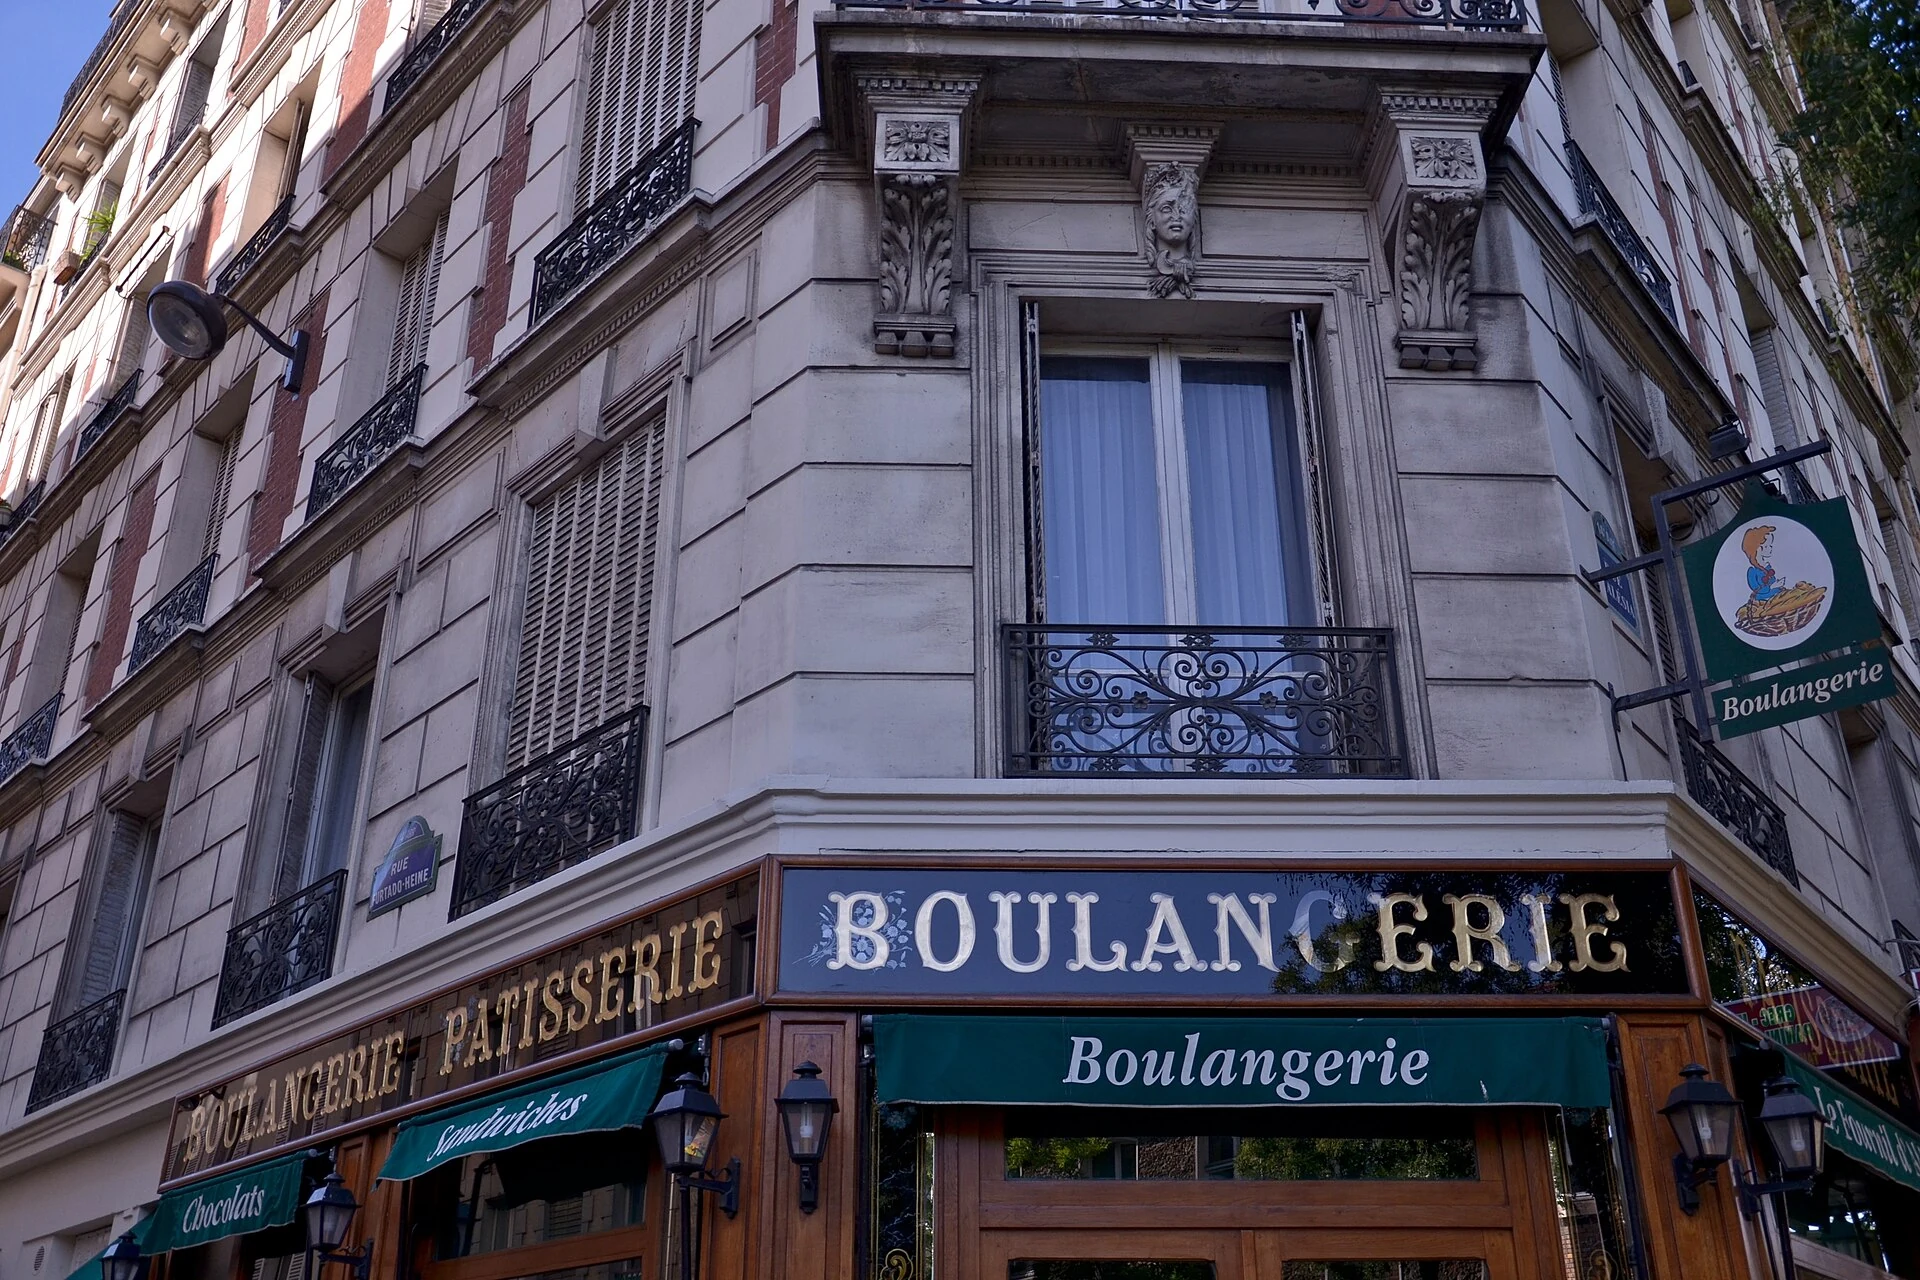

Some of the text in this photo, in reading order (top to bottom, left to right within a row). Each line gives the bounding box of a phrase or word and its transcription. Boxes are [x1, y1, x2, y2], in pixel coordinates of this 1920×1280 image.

[1722, 661, 1883, 721] Boulangerie
[391, 857, 409, 876] RUE
[827, 890, 1631, 973] BOULANGERIE
[184, 907, 723, 1162] BOULANGERIE PATISSERIE
[1062, 1032, 1429, 1100] Boulangerie
[426, 1091, 588, 1162] Sandwiches
[1813, 1086, 1839, 1134] Le
[1835, 1100, 1898, 1167] Fournil
[183, 1183, 265, 1233] Chocolats
